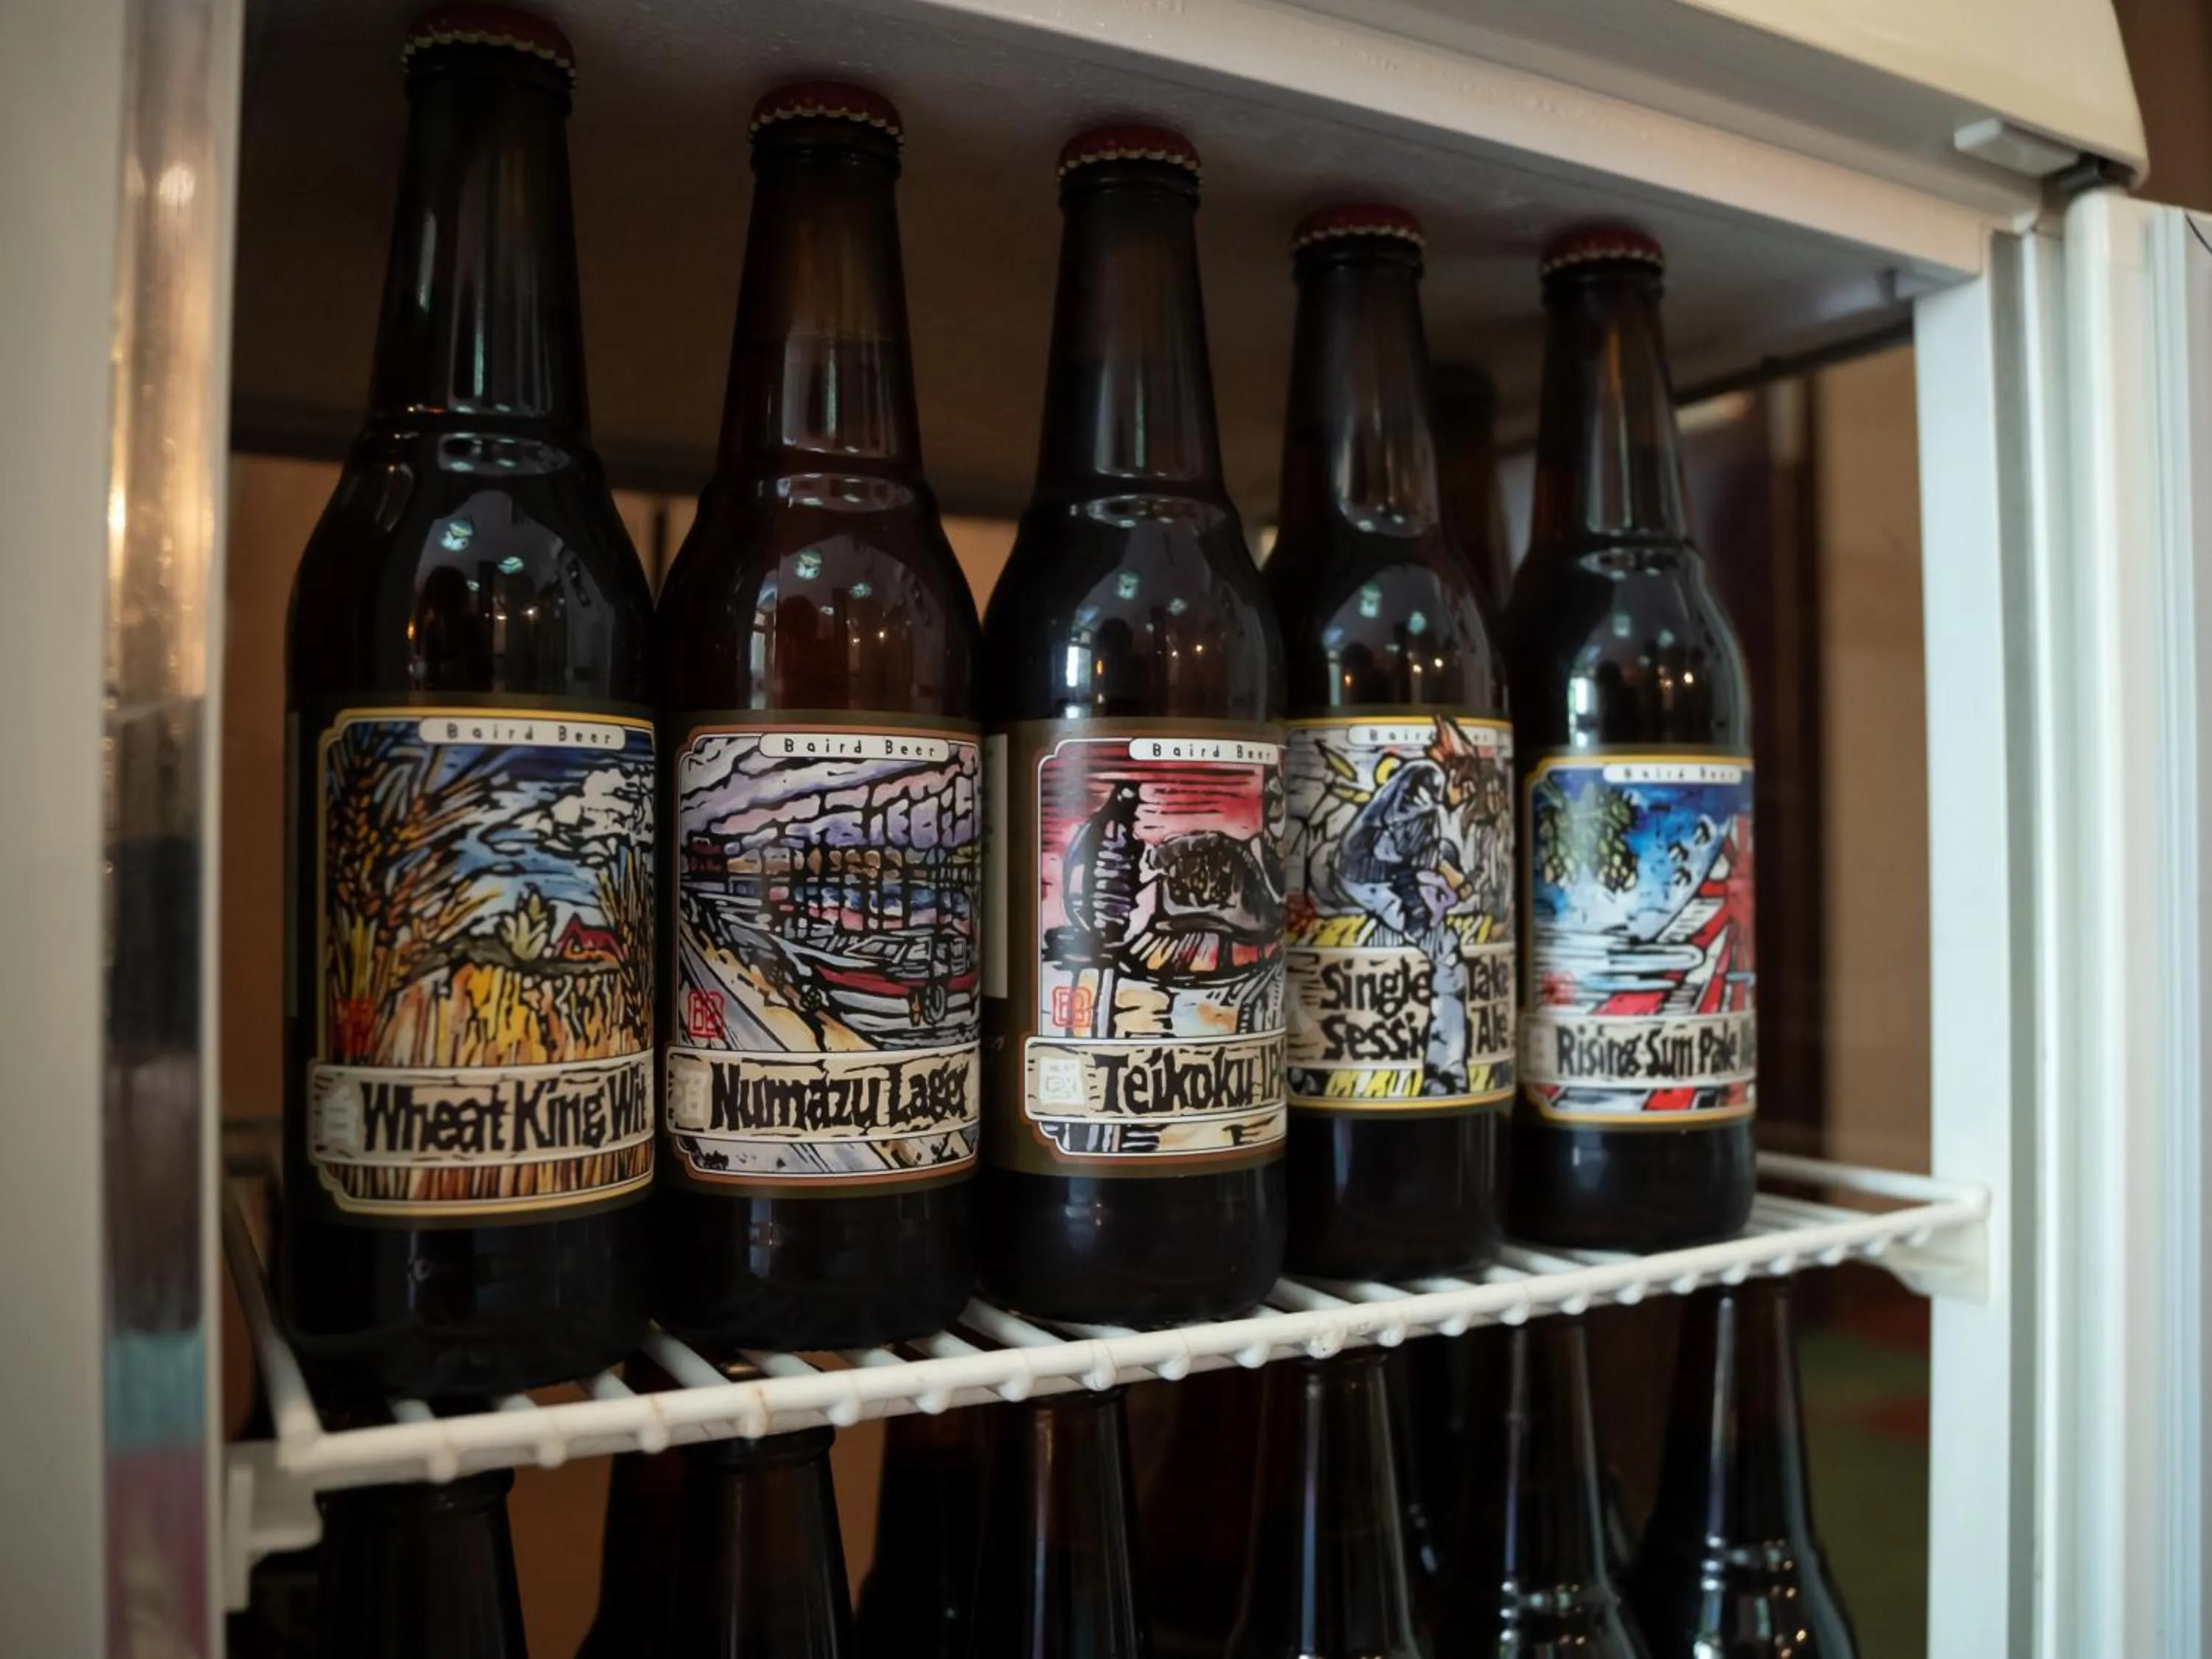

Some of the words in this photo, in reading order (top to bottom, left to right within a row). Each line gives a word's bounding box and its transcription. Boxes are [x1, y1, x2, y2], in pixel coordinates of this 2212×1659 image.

[446, 722, 534, 740] Baird
[557, 725, 611, 745] Beer
[783, 738, 863, 754] Baird
[885, 740, 936, 758] Beer
[1152, 742, 1220, 758] Baird
[1236, 744, 1271, 761] Beer
[1320, 956, 1431, 1020] Single
[1319, 1010, 1428, 1060] Sessi
[1473, 1004, 1509, 1054] Ale
[1555, 1024, 1642, 1077] Rising
[1645, 1029, 1694, 1077] Sun
[1699, 1018, 1737, 1075] Pale
[360, 1081, 509, 1152] Wheat
[512, 1077, 606, 1149] King
[607, 1062, 647, 1141] Wit
[709, 1061, 882, 1133] Numazu
[887, 1060, 969, 1127] Lager
[1091, 1047, 1253, 1115] Teikoku
